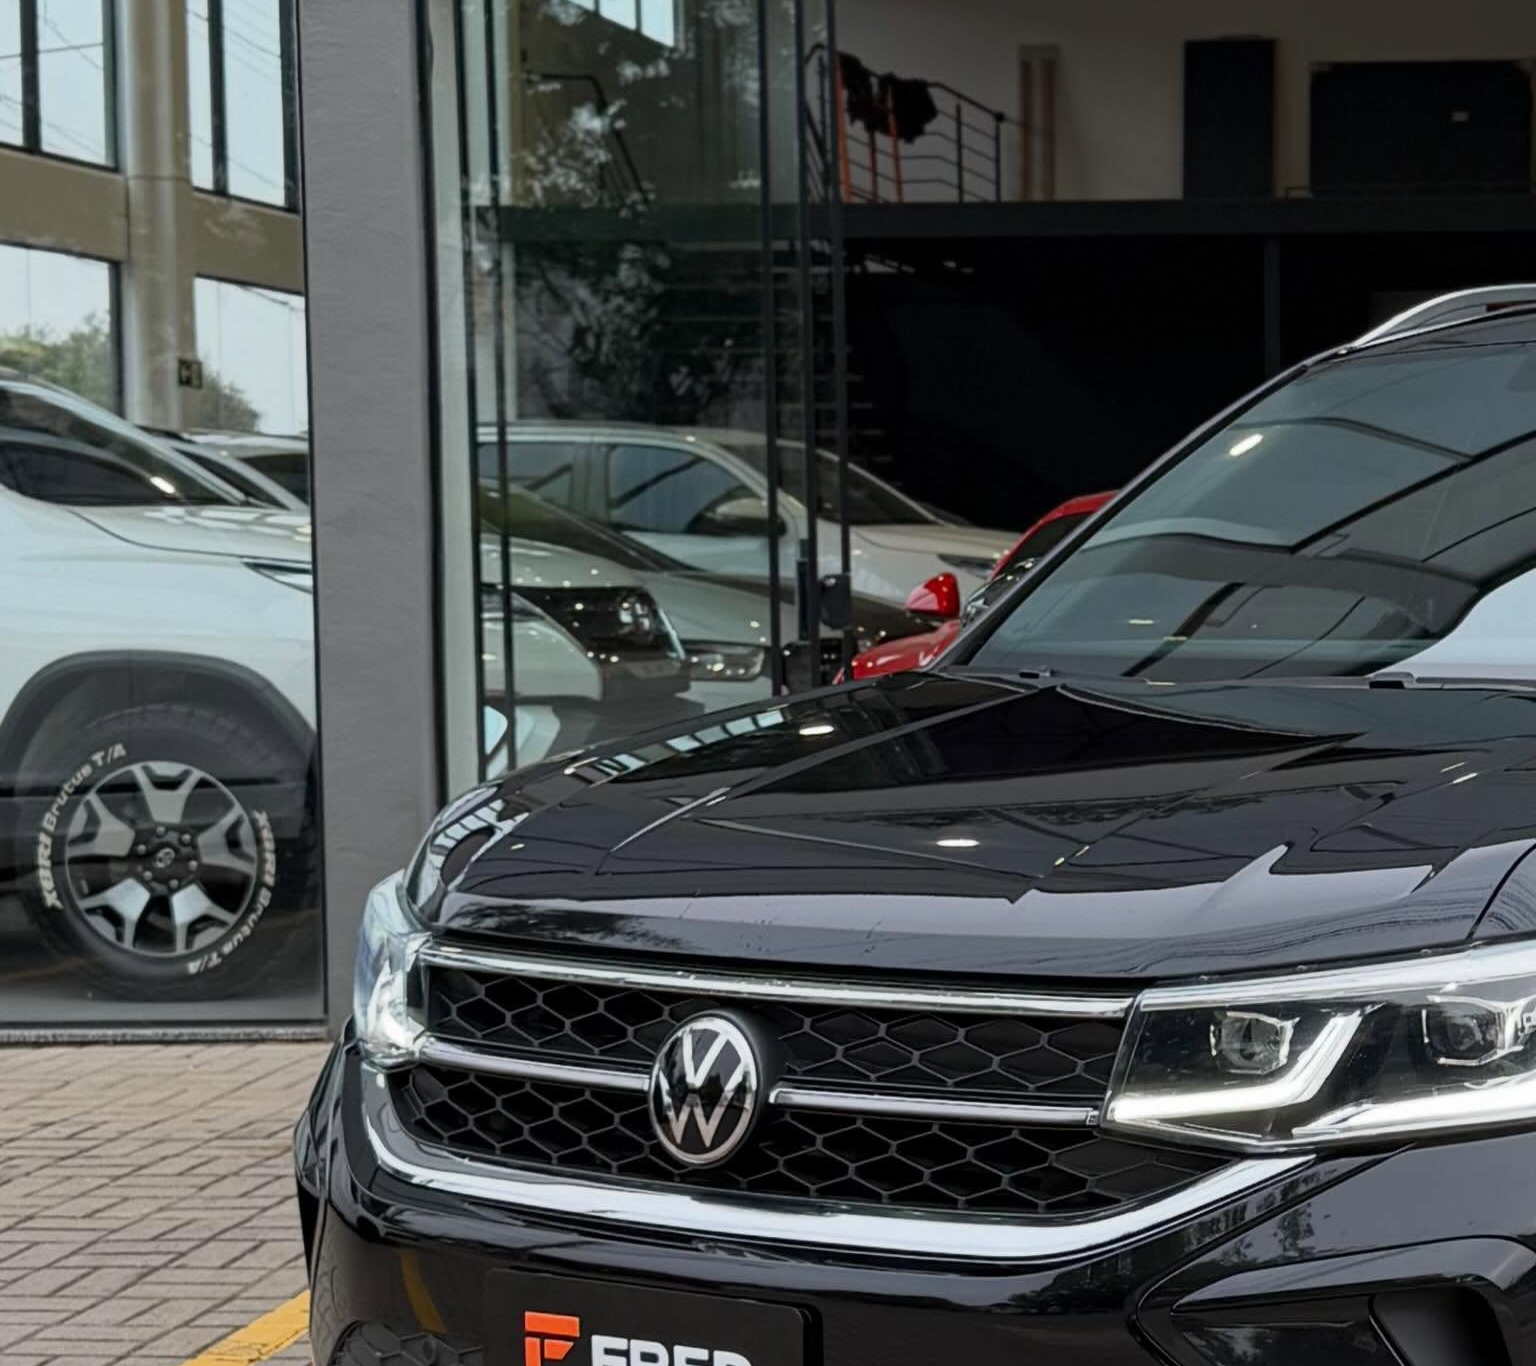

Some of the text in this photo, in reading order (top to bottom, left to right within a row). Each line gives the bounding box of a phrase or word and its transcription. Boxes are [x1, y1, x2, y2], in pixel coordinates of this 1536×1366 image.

[37, 743, 127, 910] XBRI Brutus T/A
